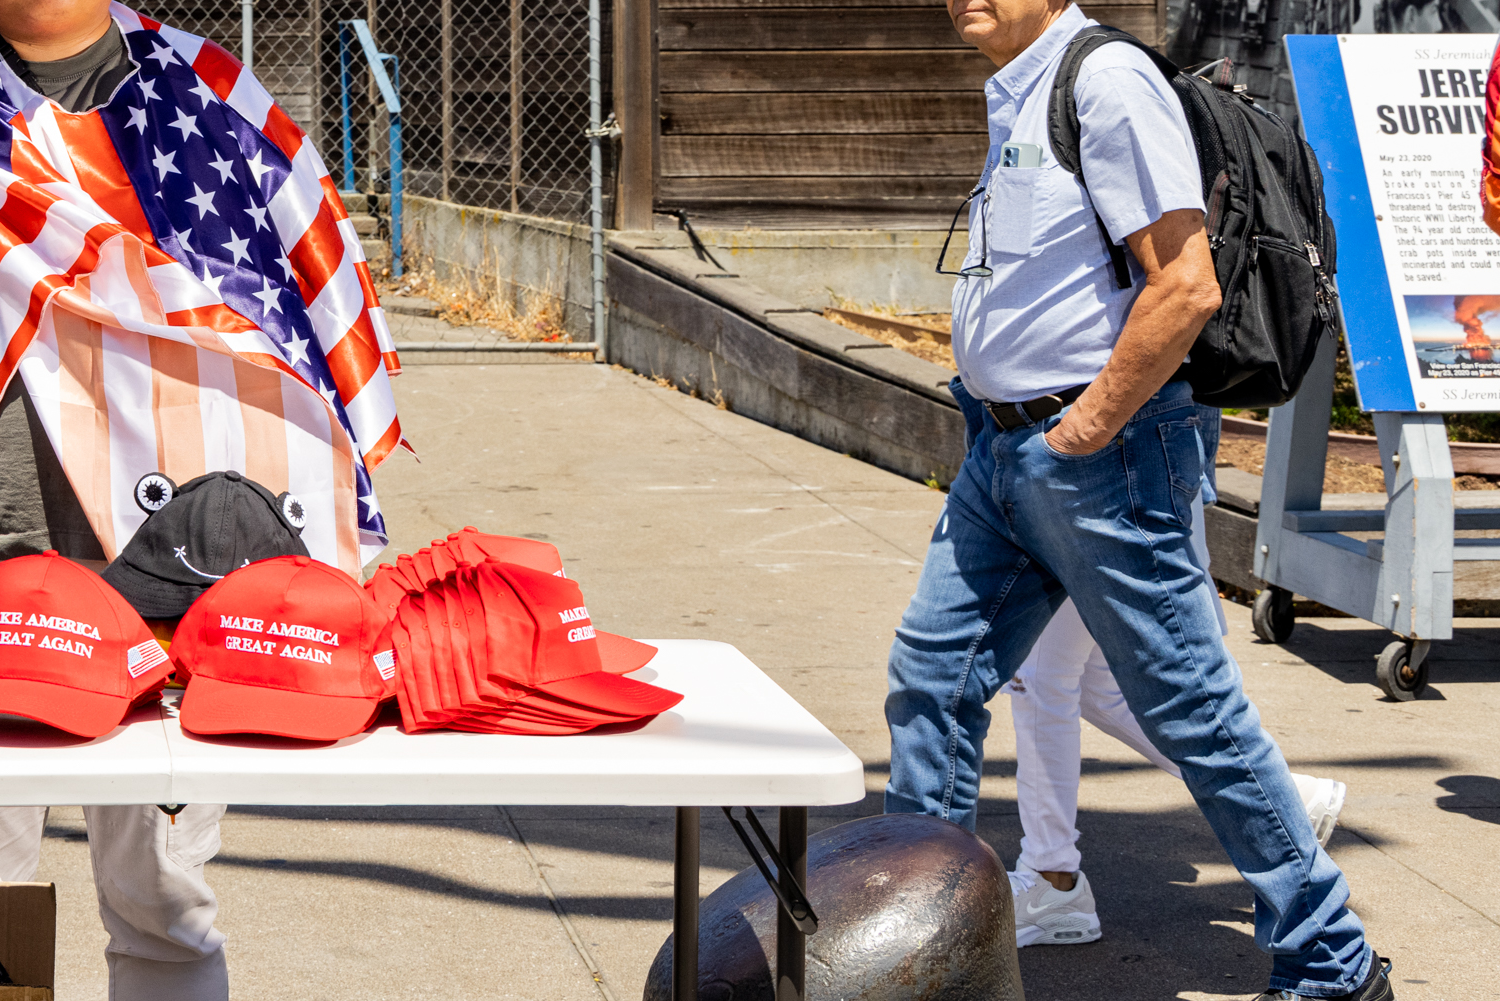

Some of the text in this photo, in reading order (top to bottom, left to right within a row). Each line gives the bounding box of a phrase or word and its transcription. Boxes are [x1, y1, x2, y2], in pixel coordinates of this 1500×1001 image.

[1414, 49, 1491, 60] SS Jeremiah
[1418, 69, 1489, 98] JERE
[1380, 155, 1394, 163] May
[1401, 169, 1421, 178] early
[1430, 170, 1465, 179] morning
[1473, 168, 1482, 176] fir
[1384, 180, 1415, 188] broke
[1425, 180, 1442, 188] out
[1387, 191, 1470, 199] Francisco's Pier 45
[1389, 203, 1476, 212] threatened to destroy
[1392, 214, 1421, 222] historic
[1448, 214, 1475, 224] Liberty
[1394, 225, 1408, 234] The
[1413, 226, 1423, 234] 94
[1427, 227, 1444, 235] year
[1450, 226, 1461, 234] old
[1426, 250, 1444, 259] pots
[1452, 249, 1476, 257] inside
[1404, 273, 1414, 281] be
[1443, 389, 1500, 400] SS Jeremi
[25, 614, 101, 641] AMERICA
[220, 615, 339, 647] MAKE AMERICA
[38, 635, 93, 659] AGAIN
[226, 636, 332, 664] GREAT AGAIN
